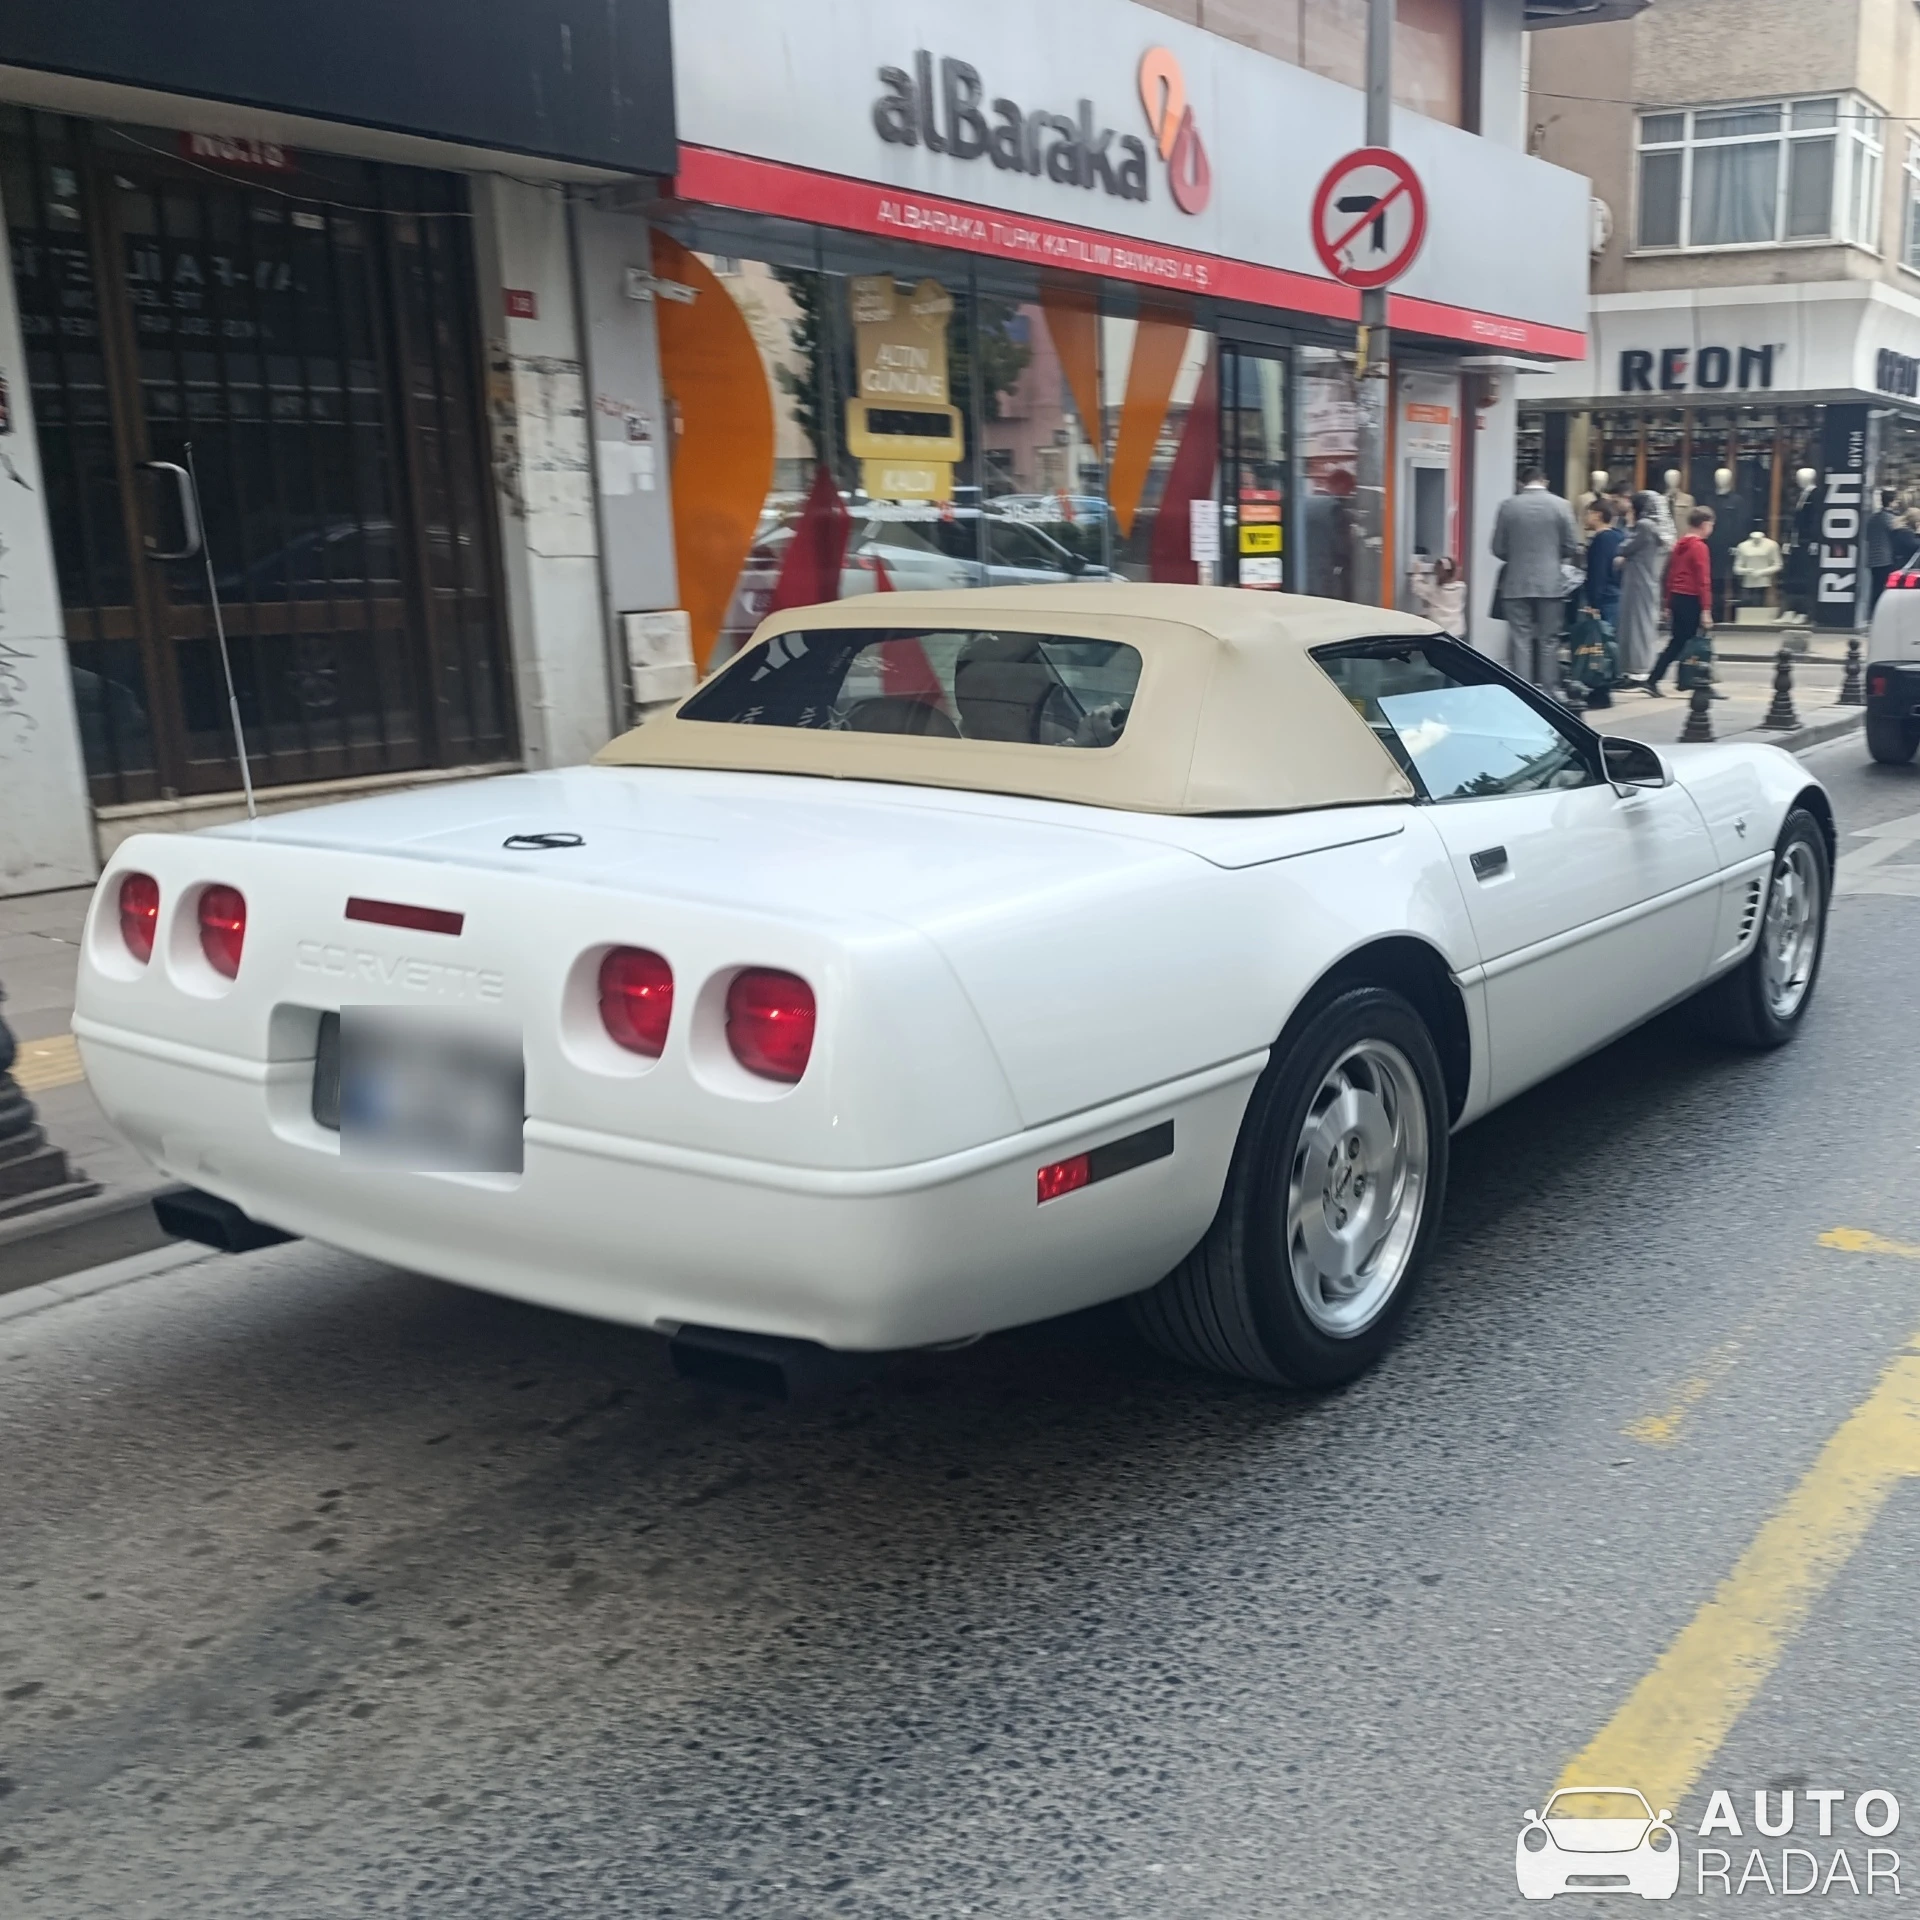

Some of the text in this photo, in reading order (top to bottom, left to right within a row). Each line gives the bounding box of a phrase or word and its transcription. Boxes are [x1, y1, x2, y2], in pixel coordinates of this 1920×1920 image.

[874, 48, 1148, 203] alBaraka
[877, 199, 988, 242] ALBARAKA
[876, 343, 930, 370] ALTIN
[1619, 343, 1774, 392] REON
[1818, 473, 1862, 603] REON
[296, 939, 504, 1003] CORVETTE
